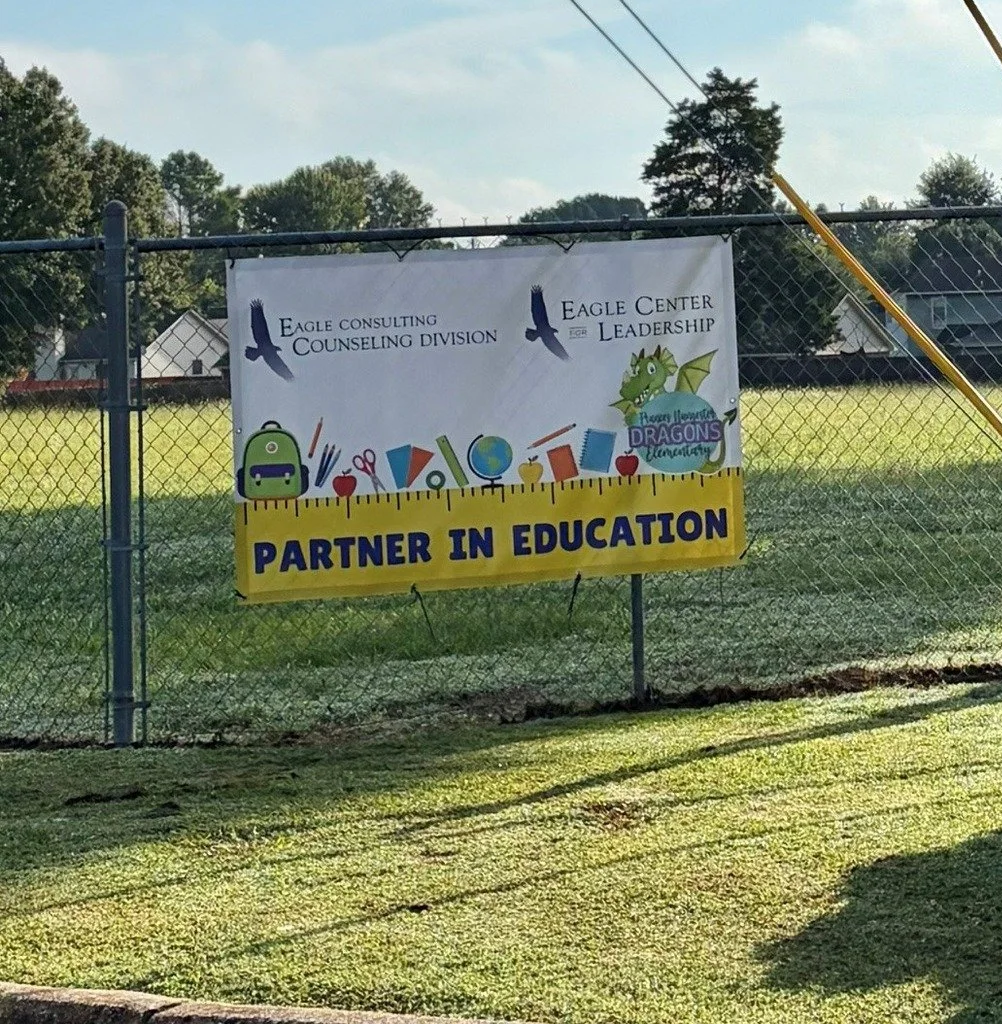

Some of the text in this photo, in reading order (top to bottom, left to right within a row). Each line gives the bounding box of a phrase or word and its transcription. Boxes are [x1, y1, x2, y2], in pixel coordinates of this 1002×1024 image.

[561, 295, 714, 320] EAGLE CENTER
[278, 314, 437, 337] EAGLE CONSULTING
[598, 317, 715, 342] LEADERSHIP
[292, 329, 498, 356] COUNSELING DIVISION
[630, 422, 721, 446] DRAGONS
[645, 444, 710, 462] Elementary
[253, 508, 729, 574] PARTNER IN EDUCATION
